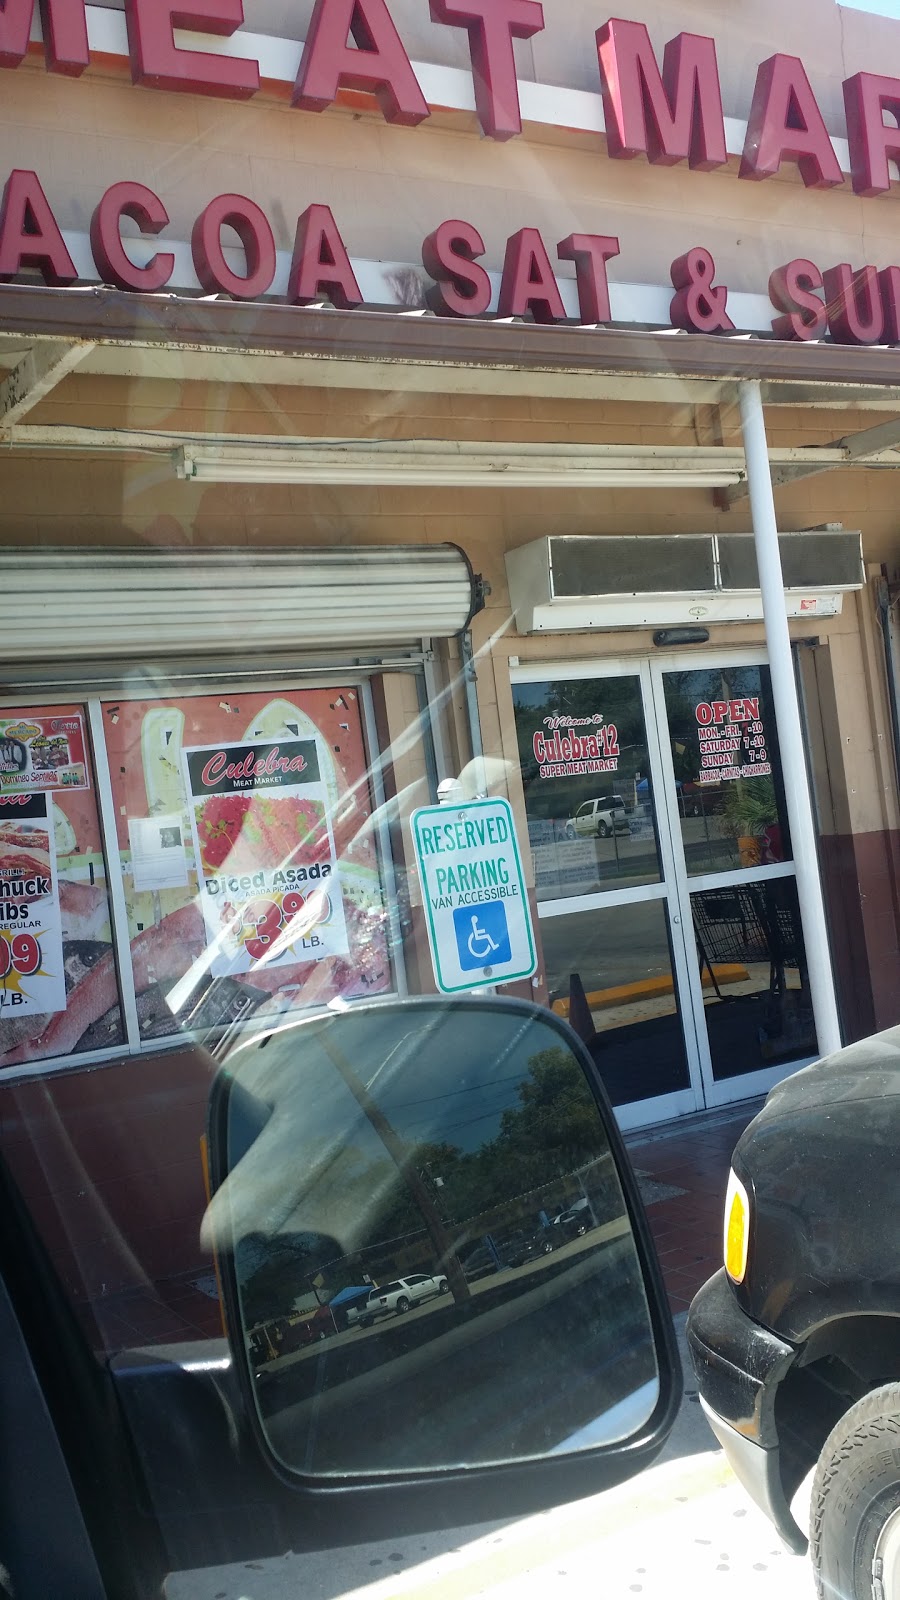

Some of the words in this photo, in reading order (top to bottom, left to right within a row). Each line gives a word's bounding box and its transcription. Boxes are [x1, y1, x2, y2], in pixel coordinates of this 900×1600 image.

[0, 168, 364, 309] ACOA
[422, 219, 620, 326] SAT
[670, 246, 736, 333] &
[543, 715, 592, 729] Welcome
[696, 698, 759, 725] OPEN
[700, 738, 741, 754] SATURDAY
[202, 747, 308, 786] Culebra
[540, 763, 566, 778] SUPER
[566, 761, 587, 775] MEAT
[587, 758, 618, 773] MARKET
[701, 752, 734, 768] SUNDAY
[233, 779, 252, 787] MEAT
[254, 776, 283, 785] MARKET
[421, 816, 509, 855] RESERVED
[0, 876, 49, 898] huck
[205, 872, 266, 895] Diced
[273, 863, 332, 886] Asada
[435, 857, 510, 896] PARKING
[245, 887, 271, 897] ASADA
[273, 884, 300, 892] PICADA
[432, 896, 453, 909] VAN
[458, 884, 519, 906] ACCESSIBLE
[302, 935, 324, 949] LB.
[1, 993, 28, 1006] LB.
